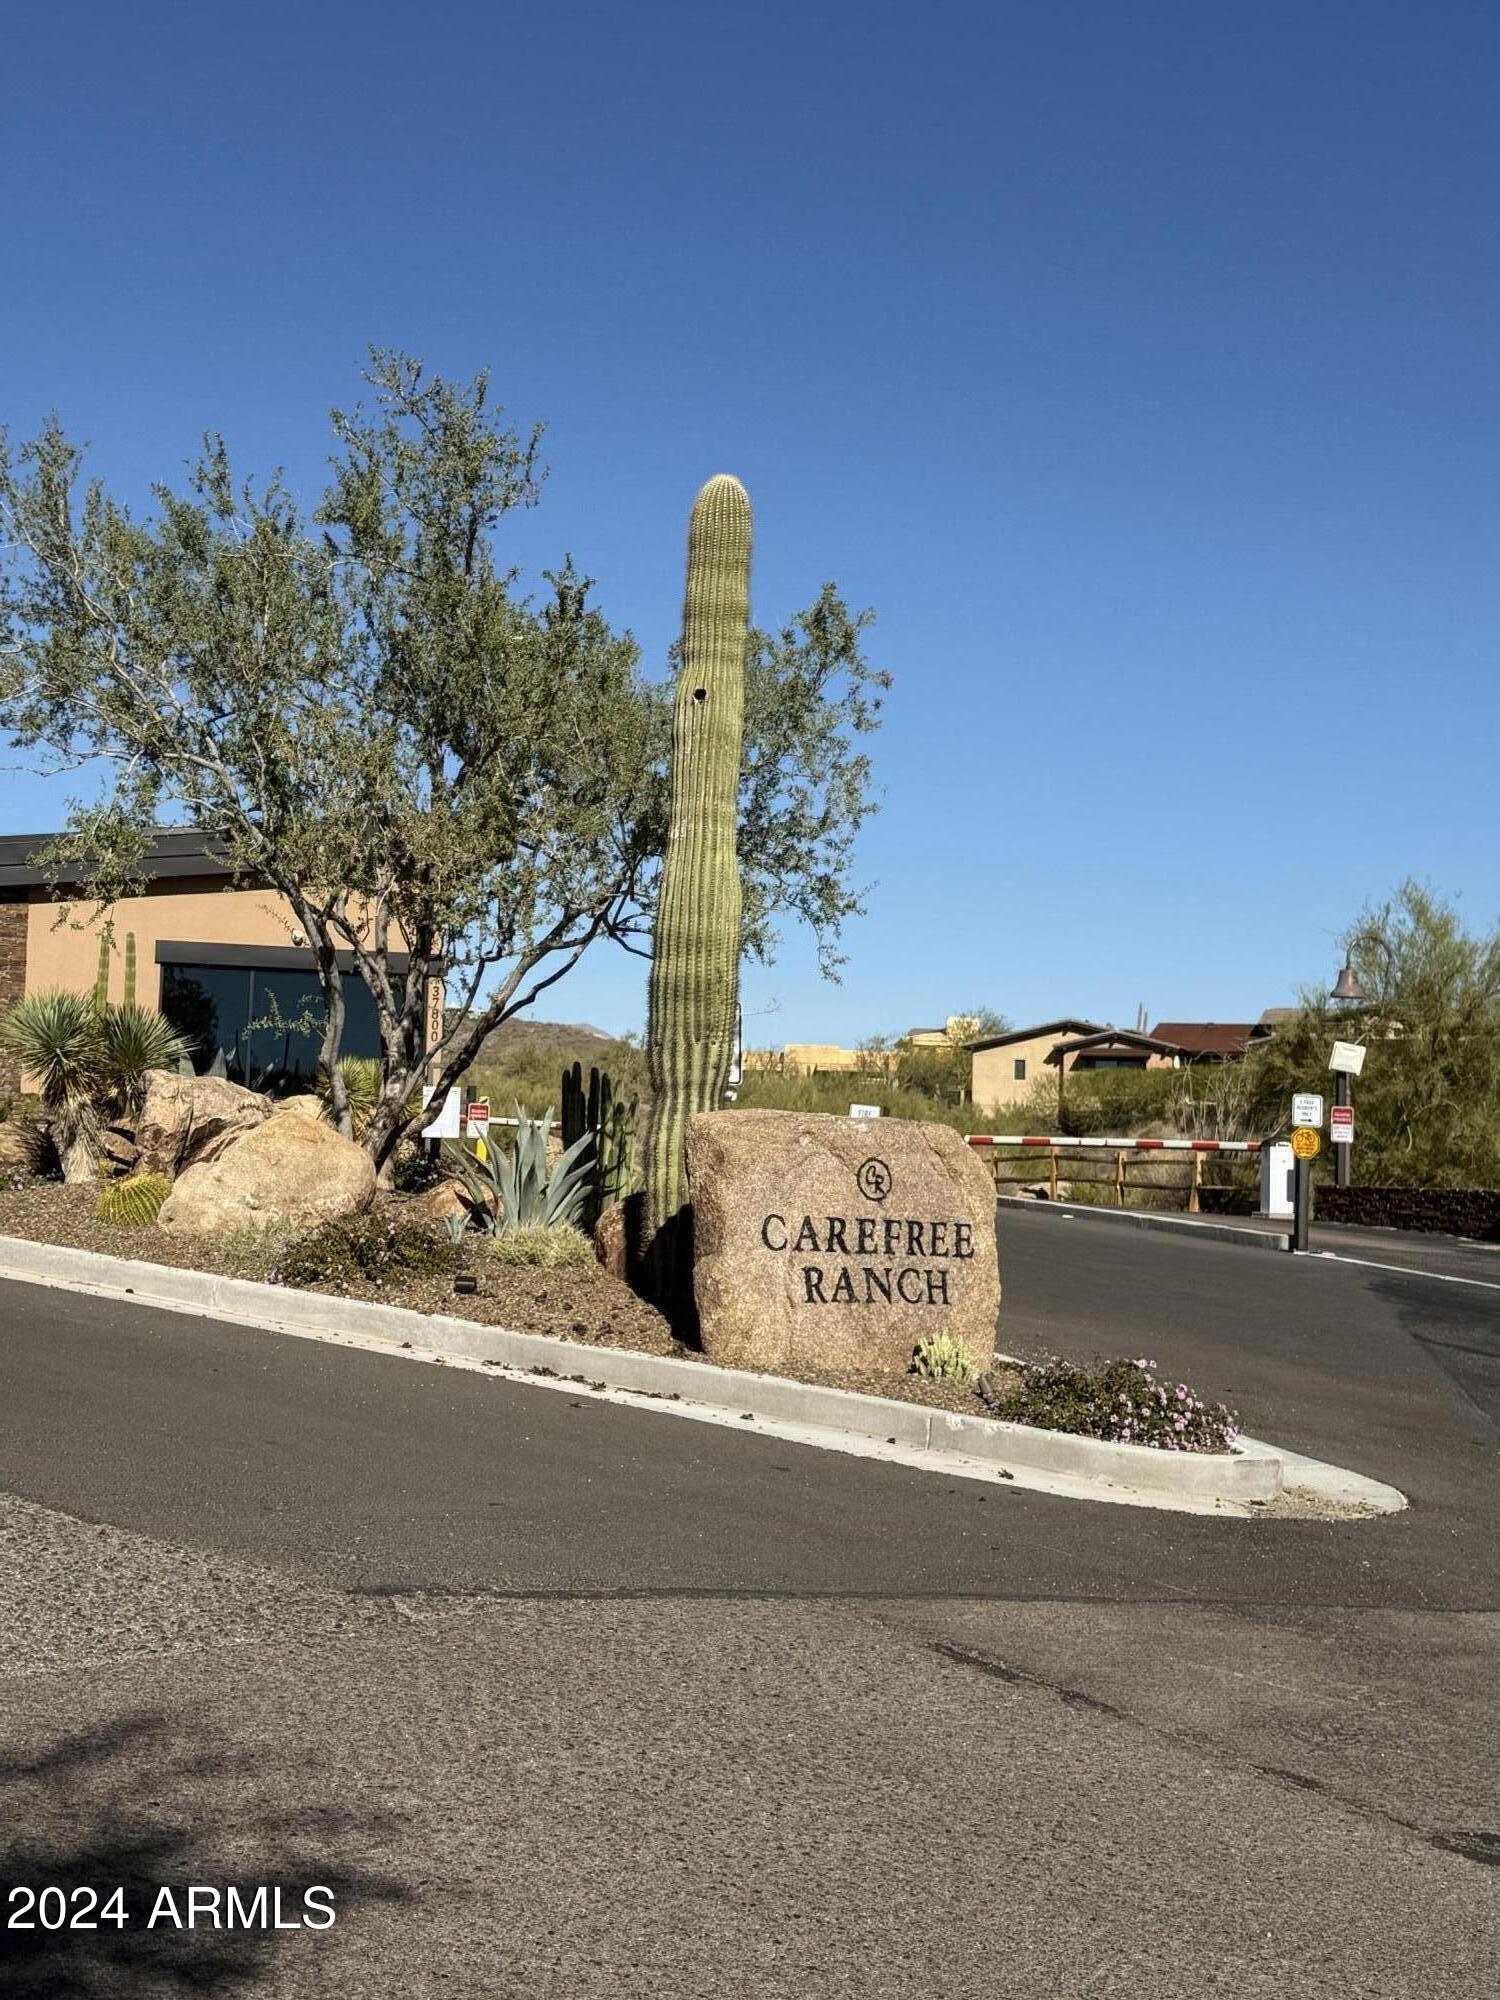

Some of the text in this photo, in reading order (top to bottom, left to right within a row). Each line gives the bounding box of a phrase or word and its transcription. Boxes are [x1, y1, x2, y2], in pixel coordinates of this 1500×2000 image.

[431, 986, 440, 1042] 37800
[761, 1213, 975, 1259] CAREFREE
[801, 1266, 951, 1305] RANCH
